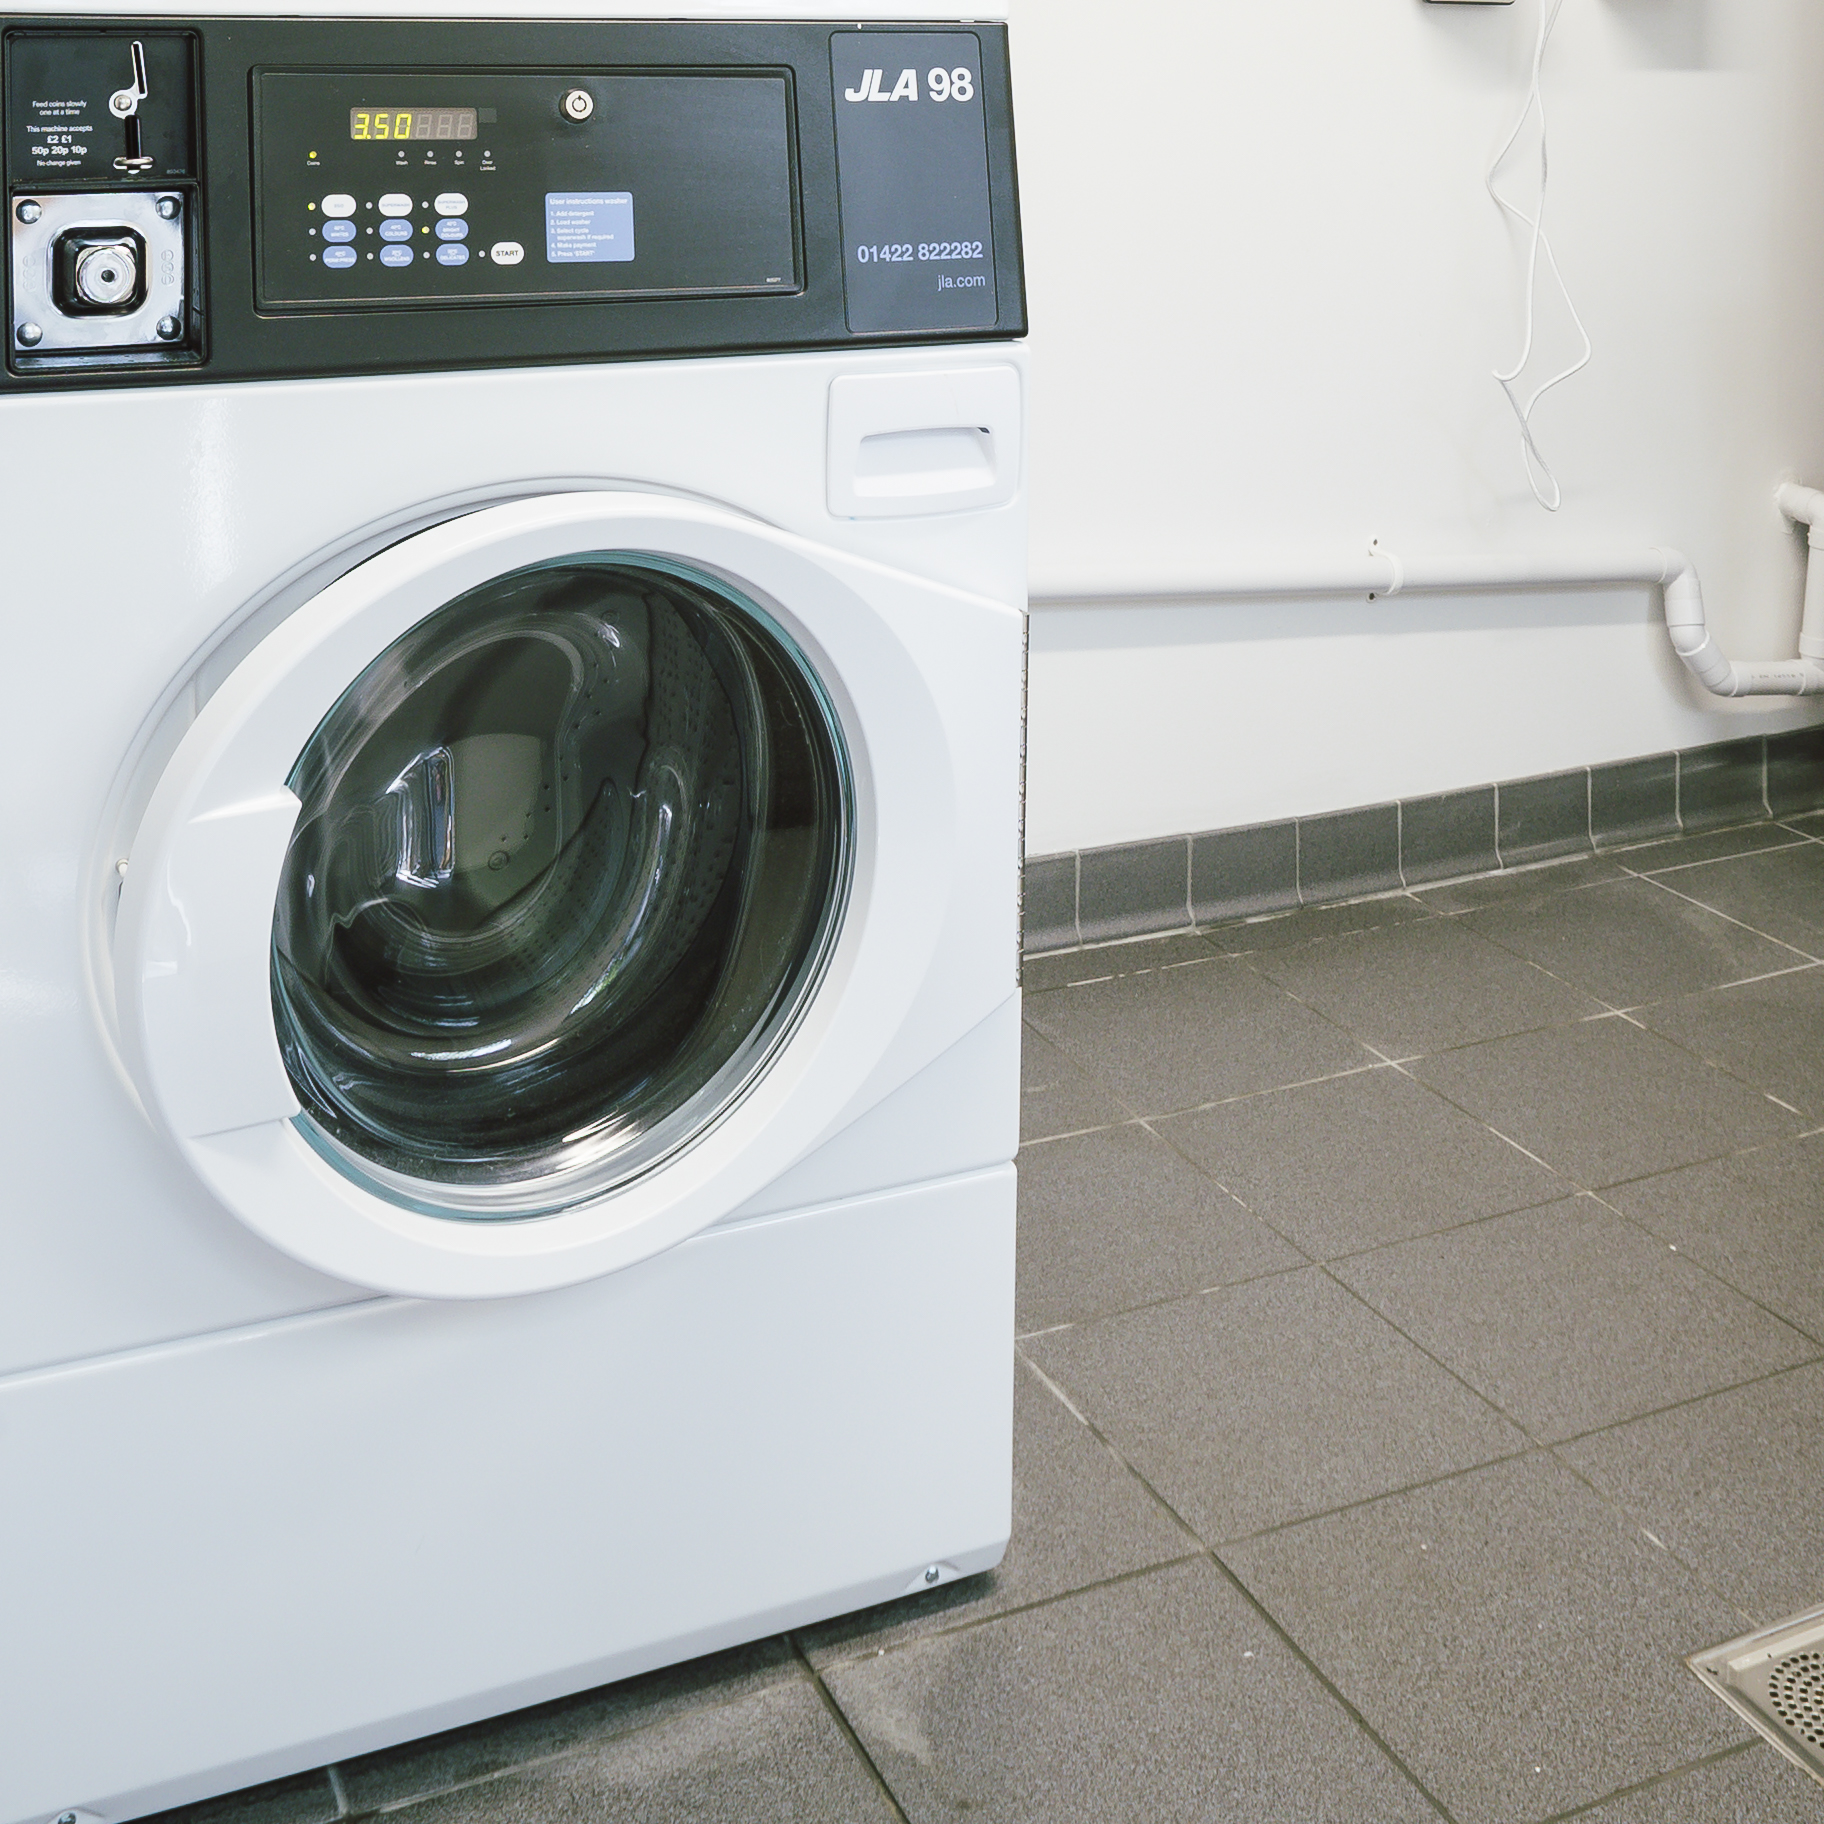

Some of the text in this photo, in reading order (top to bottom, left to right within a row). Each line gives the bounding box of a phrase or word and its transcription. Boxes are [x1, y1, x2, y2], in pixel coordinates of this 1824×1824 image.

[844, 67, 974, 102] JLA 98
[66, 100, 87, 108] slowly
[69, 125, 93, 133] accepts
[354, 114, 412, 139] 3.50
[47, 135, 72, 143] £2 £1
[32, 145, 87, 156] 50p 20p 10p
[857, 241, 983, 263] 01422 822282
[938, 275, 986, 291] jla.com
